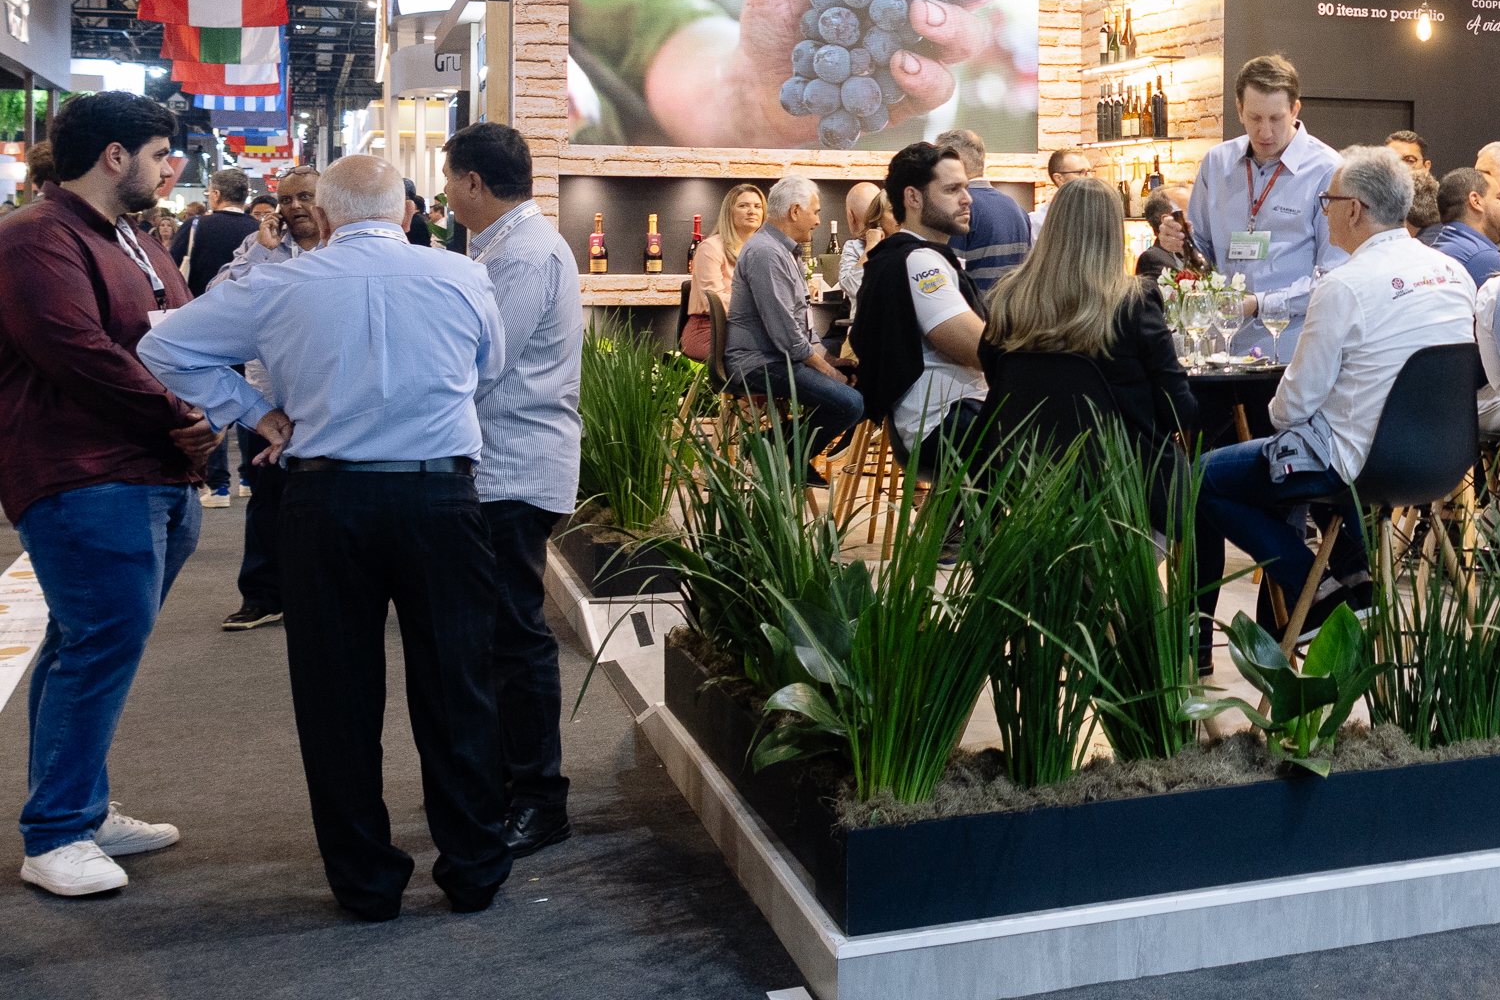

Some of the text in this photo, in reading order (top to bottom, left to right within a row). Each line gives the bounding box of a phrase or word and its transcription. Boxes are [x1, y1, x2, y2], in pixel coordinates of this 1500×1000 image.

[1317, 2, 1445, 22] 90 itens no portflio
[1466, 14, 1481, 35] A
